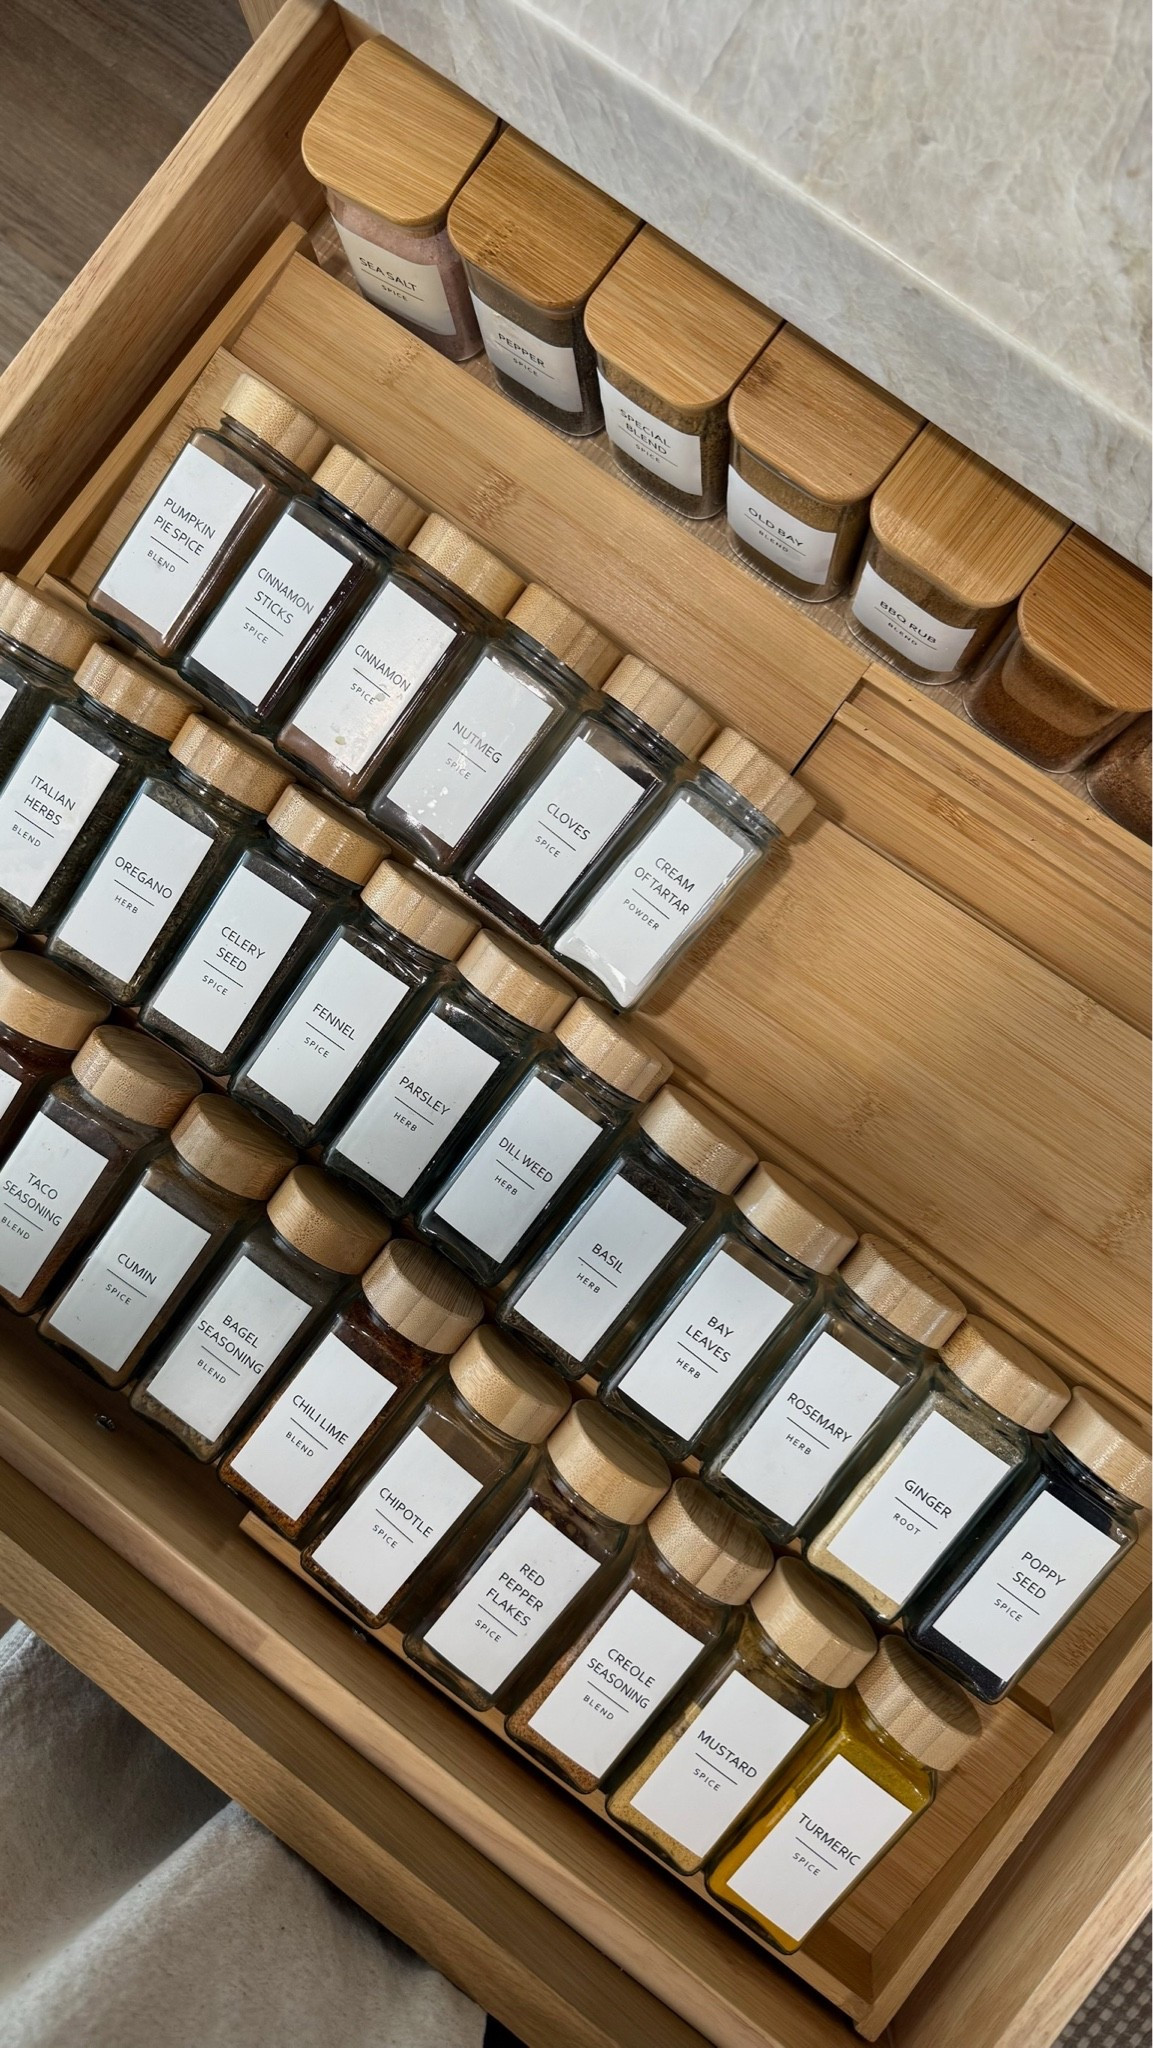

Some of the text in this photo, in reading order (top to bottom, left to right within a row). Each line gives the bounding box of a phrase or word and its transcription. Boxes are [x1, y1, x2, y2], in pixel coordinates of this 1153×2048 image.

[358, 256, 418, 292] SEA SALT
[381, 285, 407, 302] SPICE
[498, 332, 545, 366] PEPPER
[513, 358, 538, 378] SPICE
[619, 408, 671, 447] SPECIAL
[625, 422, 667, 456] BLEND
[635, 444, 661, 464] SPICE
[164, 497, 216, 540] PUMPKIN
[747, 507, 803, 548] OLD BAY
[171, 527, 205, 556] SPICE
[758, 530, 789, 553] BLEND
[147, 550, 177, 573] BLEND
[257, 567, 314, 615] CINNAMON
[254, 590, 294, 625] STICKS
[879, 600, 936, 645] BBQ RUB
[243, 622, 269, 645] SPICE
[887, 622, 918, 646] BLEND
[354, 644, 411, 691] CINNAMON
[350, 682, 376, 705] SPICE
[452, 721, 503, 764] NUTMEG
[445, 757, 471, 780] SPICE
[30, 775, 76, 812] ITALIAN
[24, 794, 62, 826] HERBS
[547, 802, 591, 841] CLOVES
[12, 824, 41, 847] BLEND
[534, 835, 561, 858] SPICE
[114, 856, 173, 899] OREGANO
[655, 857, 695, 893] CREAM
[114, 894, 139, 914] HERB
[622, 898, 660, 930] POWDER
[221, 926, 265, 960] CELERY
[216, 946, 247, 972] SEED
[202, 974, 228, 996] SPICE
[312, 1002, 357, 1040] FENNEL
[304, 1036, 330, 1058] SPICE
[399, 1076, 451, 1116] PARSLEY
[393, 1112, 418, 1132] HERB
[498, 1136, 554, 1183] DILL WEED
[28, 1173, 58, 1200] TACO
[494, 1175, 518, 1196] HERB
[2, 1180, 62, 1228] SEASONING
[1, 1216, 30, 1240] BLEND
[117, 1253, 157, 1286] CUMIN
[591, 1243, 624, 1274] BASIL
[105, 1283, 132, 1306] SPICE
[576, 1272, 601, 1294] HERB
[222, 1314, 260, 1349] BAGEL
[707, 1316, 735, 1338] BAY
[197, 1320, 264, 1375] SEASONING
[685, 1324, 731, 1363] LEAVES
[197, 1359, 227, 1384] BLEND
[676, 1357, 702, 1379] HERB
[292, 1394, 349, 1445] CHILI LIME
[787, 1393, 852, 1443] ROSEMARY
[285, 1430, 314, 1458] BLEND
[785, 1433, 812, 1455] HERB
[379, 1487, 434, 1539] CHIPOTLE
[904, 1479, 953, 1519] GINGER
[372, 1524, 398, 1549] SPICE
[893, 1512, 921, 1536] ROOT
[519, 1563, 546, 1587] RED
[1021, 1551, 1067, 1587] POPPY
[498, 1572, 543, 1612] PEPPER
[1012, 1571, 1046, 1599] SEED
[486, 1588, 532, 1627] FLAKES
[994, 1597, 1023, 1622] SPICE
[474, 1619, 502, 1643] SPICE
[586, 1657, 650, 1709] SEASONING
[607, 1648, 656, 1689] CREOLE
[582, 1695, 614, 1721] BLEND
[696, 1730, 758, 1779] MUSTARD
[693, 1768, 721, 1791] SPICE
[798, 1812, 861, 1866] TURMERIC
[792, 1852, 820, 1877] SPICE
